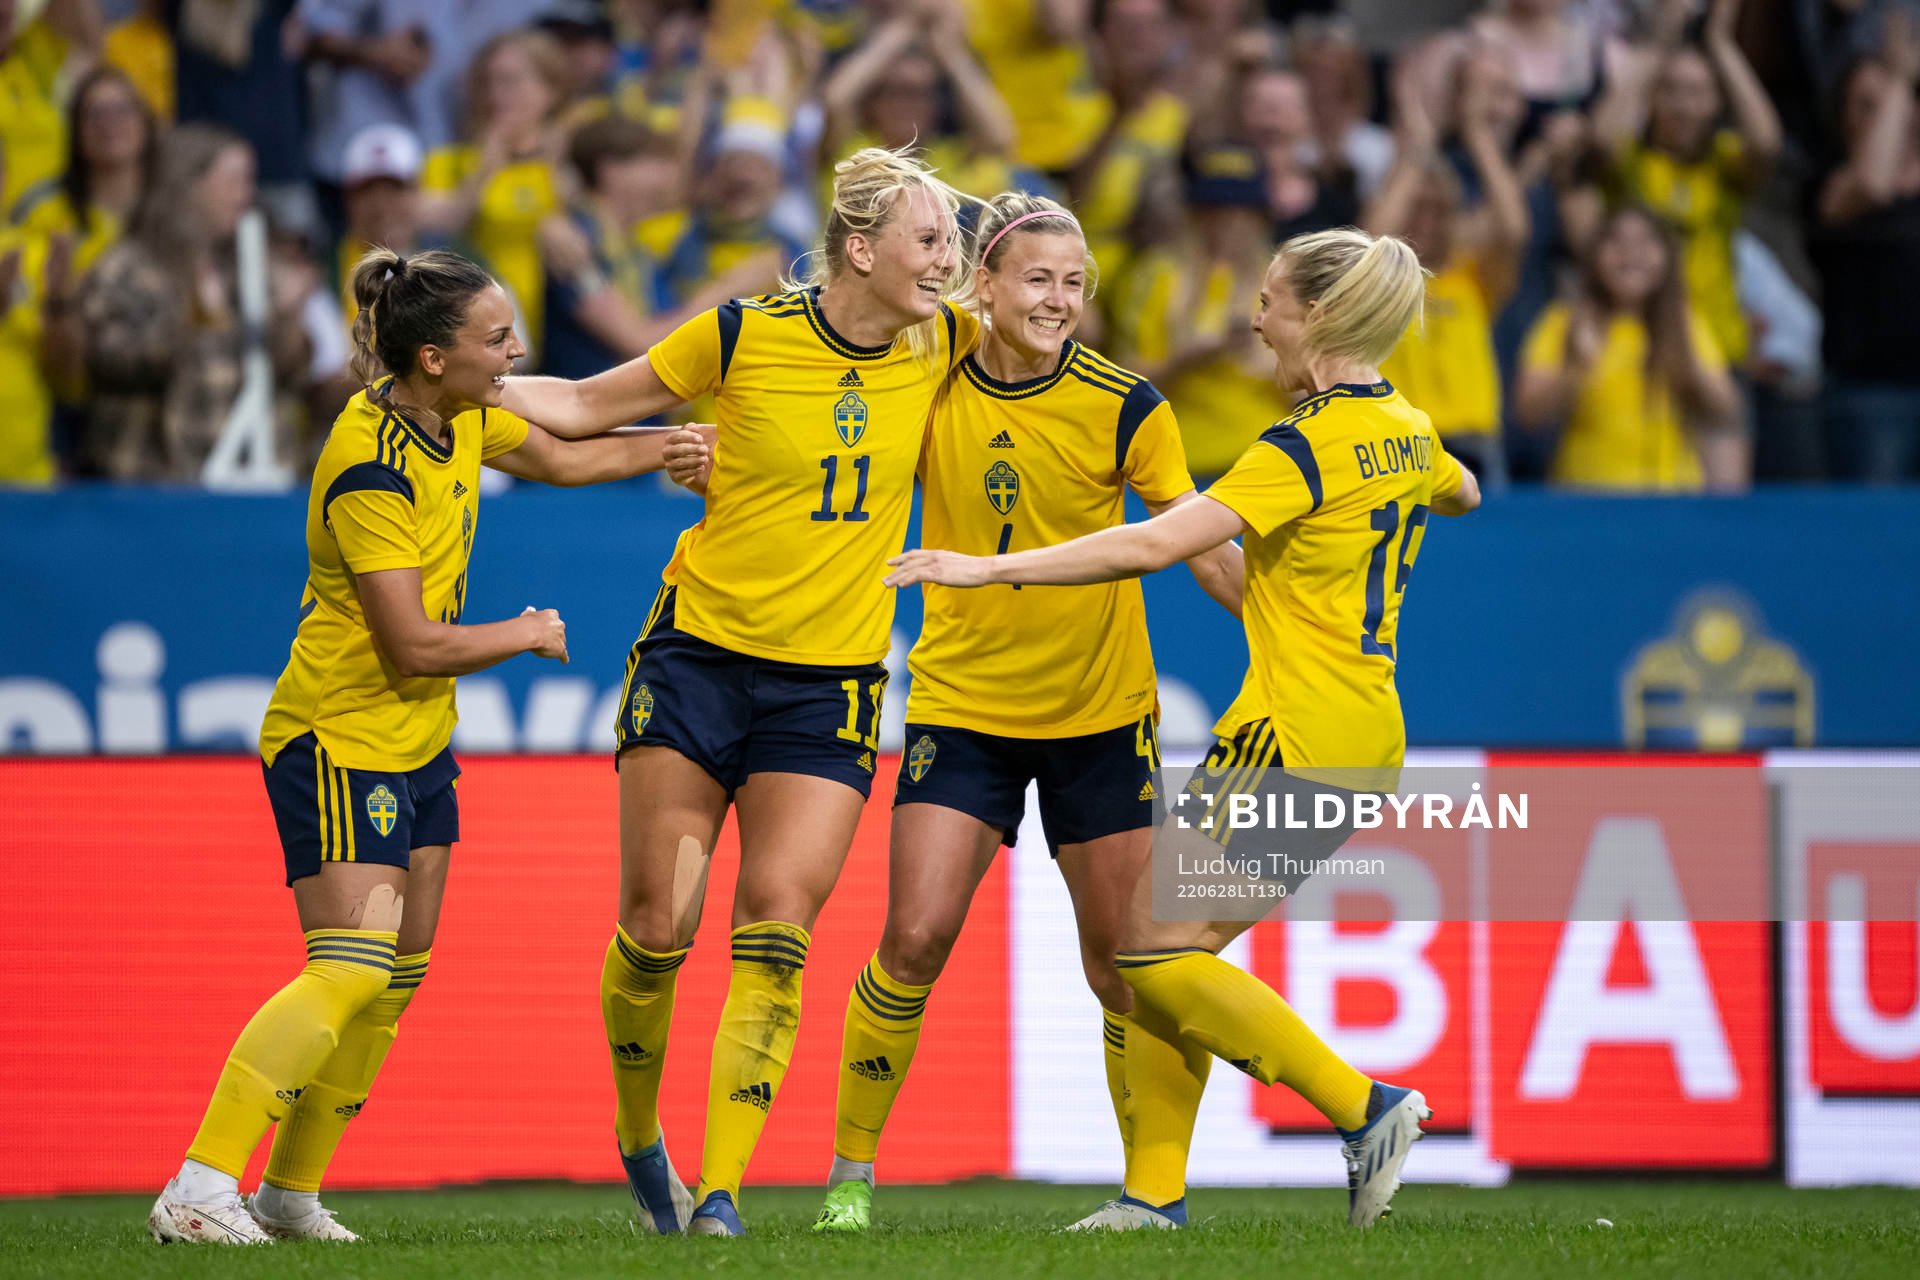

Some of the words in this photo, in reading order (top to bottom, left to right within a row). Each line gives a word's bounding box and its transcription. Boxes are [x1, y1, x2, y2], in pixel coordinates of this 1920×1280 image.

[810, 455, 871, 522] 11
[836, 679, 880, 752] 11
[849, 1062, 896, 1082] adidas
